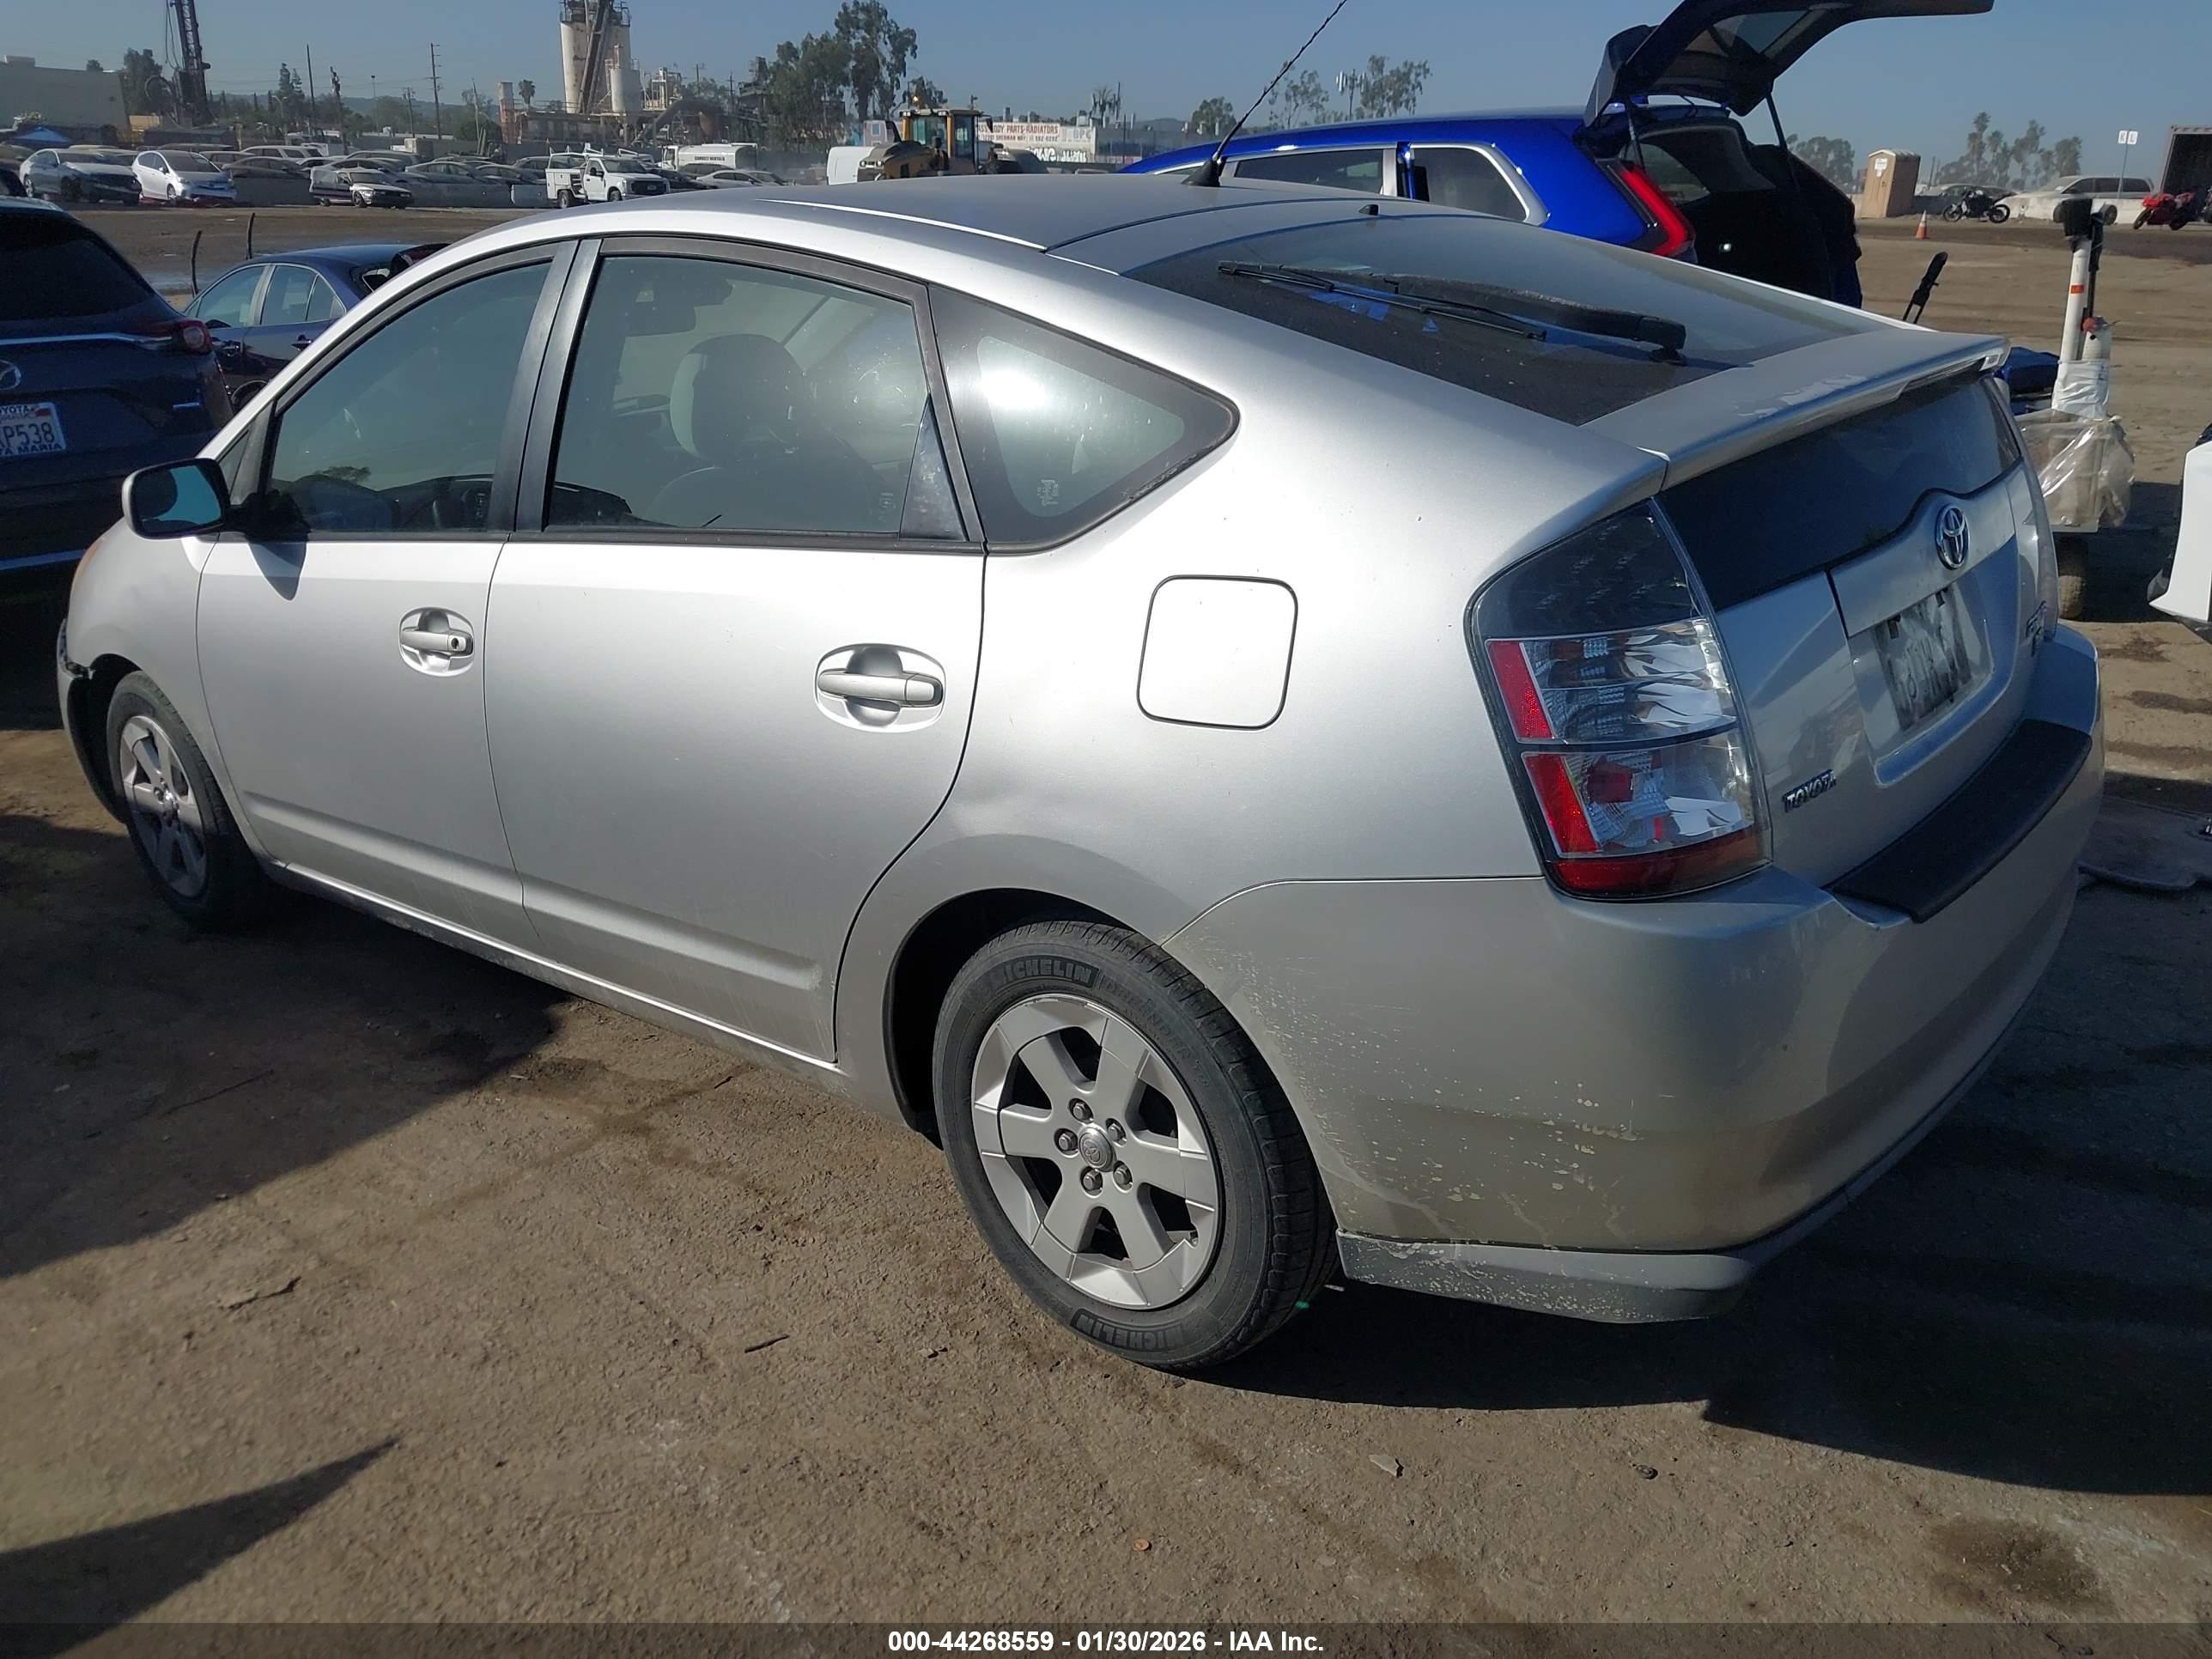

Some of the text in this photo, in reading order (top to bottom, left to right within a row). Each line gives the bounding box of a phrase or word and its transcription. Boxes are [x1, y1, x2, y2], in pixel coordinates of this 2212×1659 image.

[0, 405, 28, 414] YOTA
[0, 422, 55, 447] P538
[1784, 770, 1837, 811] TOYOTA
[989, 958, 1092, 985] ICHELIN
